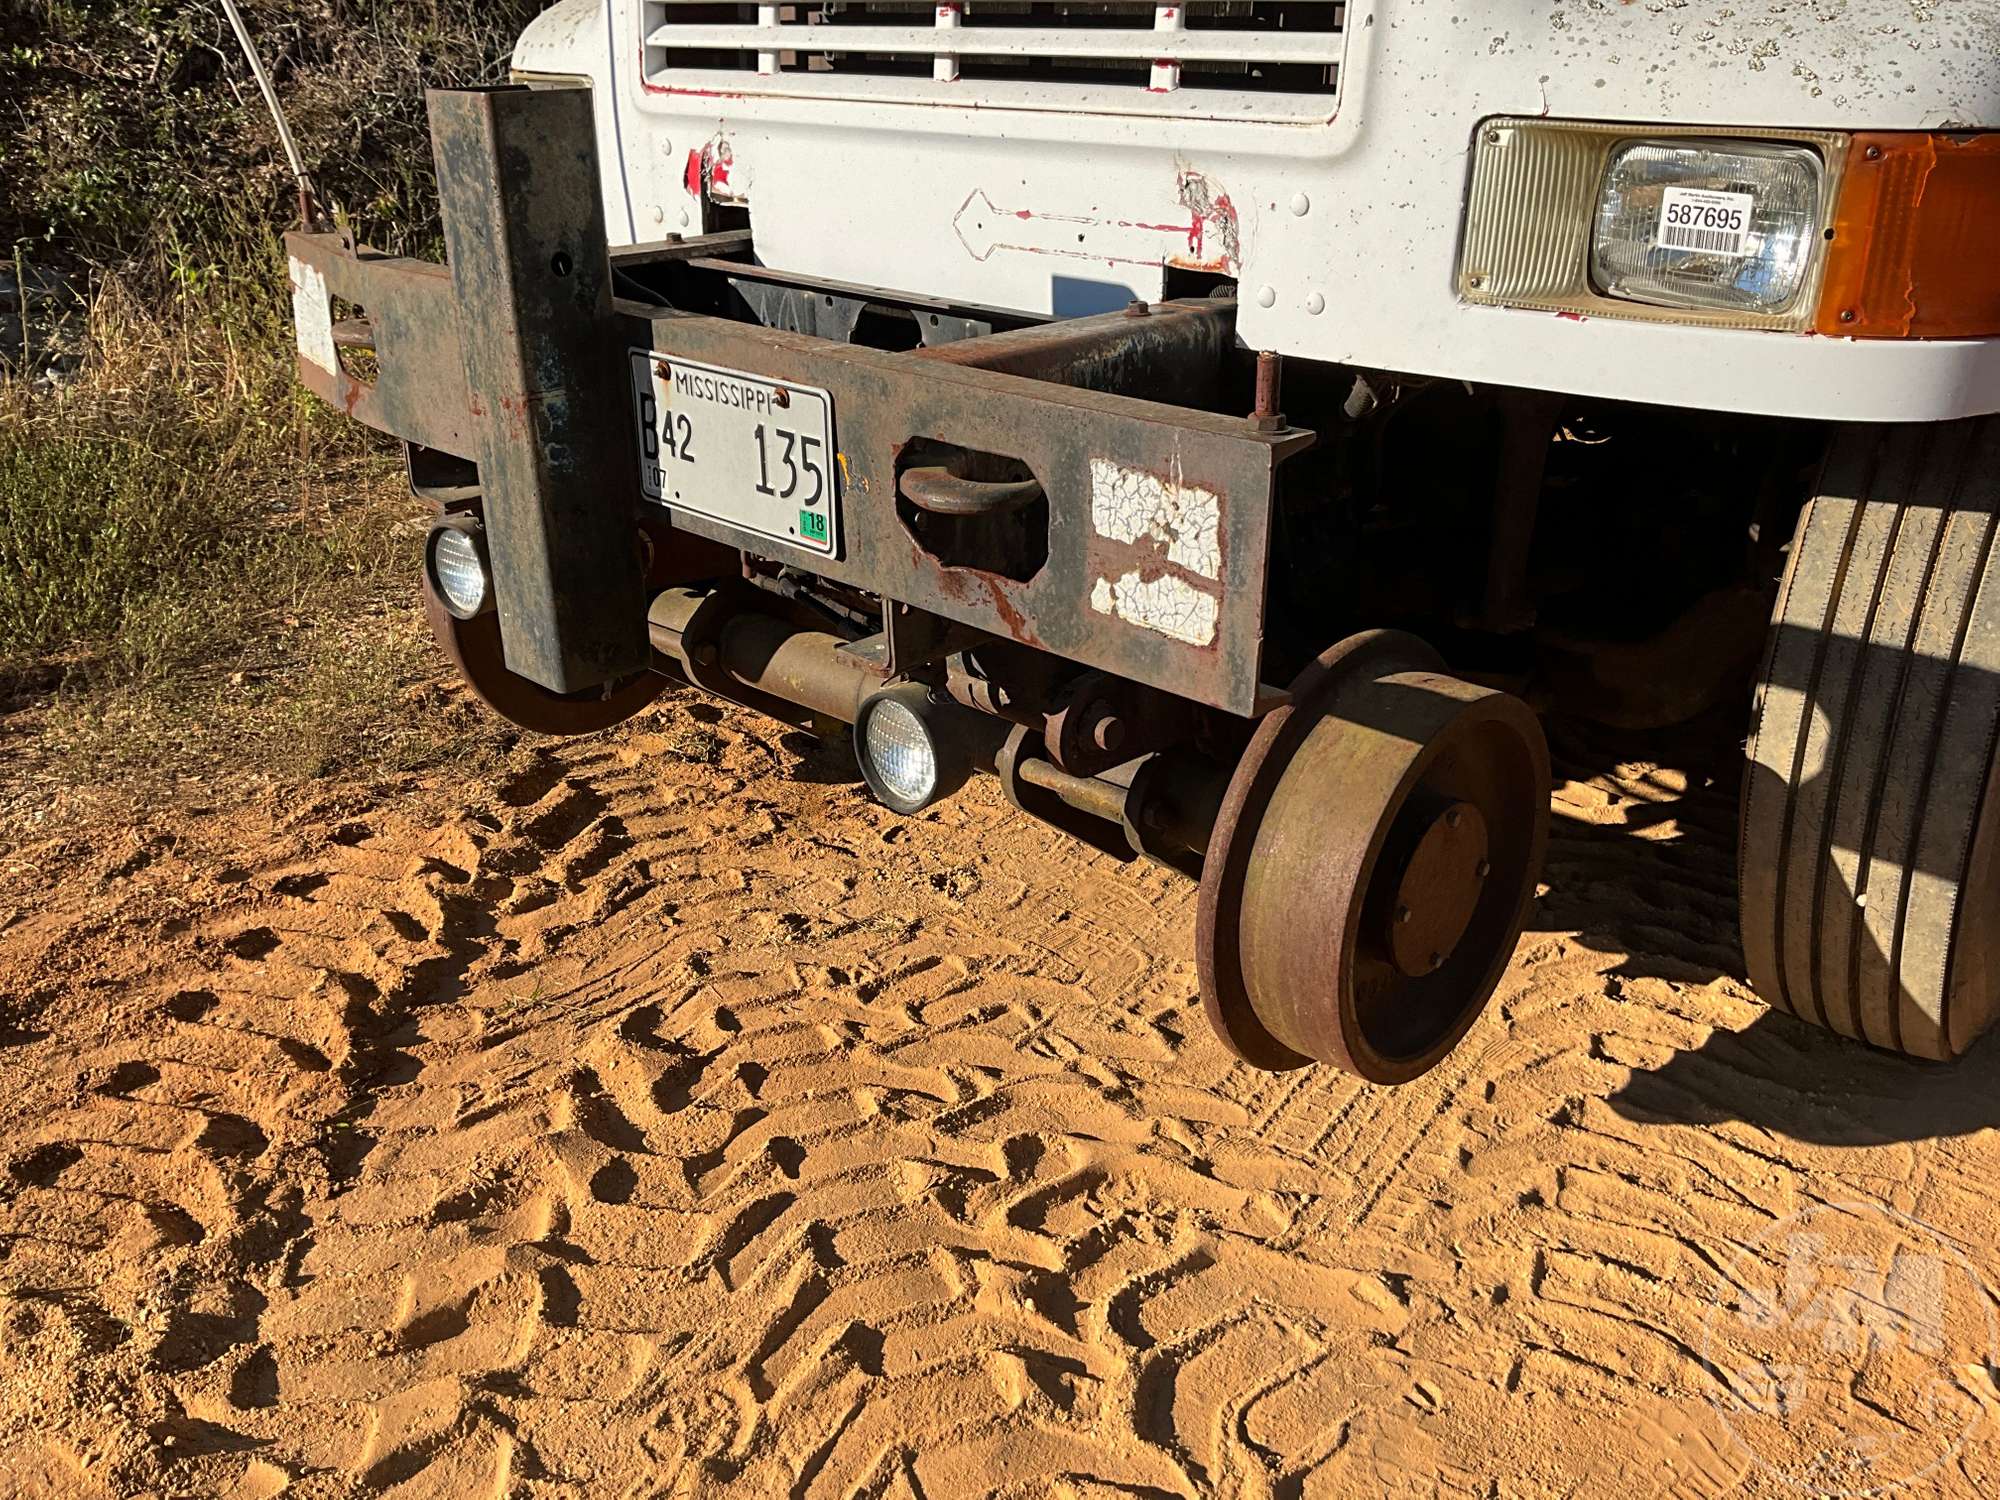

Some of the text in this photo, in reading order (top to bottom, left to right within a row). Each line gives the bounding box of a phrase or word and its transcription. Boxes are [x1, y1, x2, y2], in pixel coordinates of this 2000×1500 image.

[1667, 203, 1742, 230] 587695
[675, 370, 772, 416] MISSISSIPPI
[652, 464, 666, 488] 07
[754, 423, 823, 507] 135
[808, 512, 824, 532] 18
